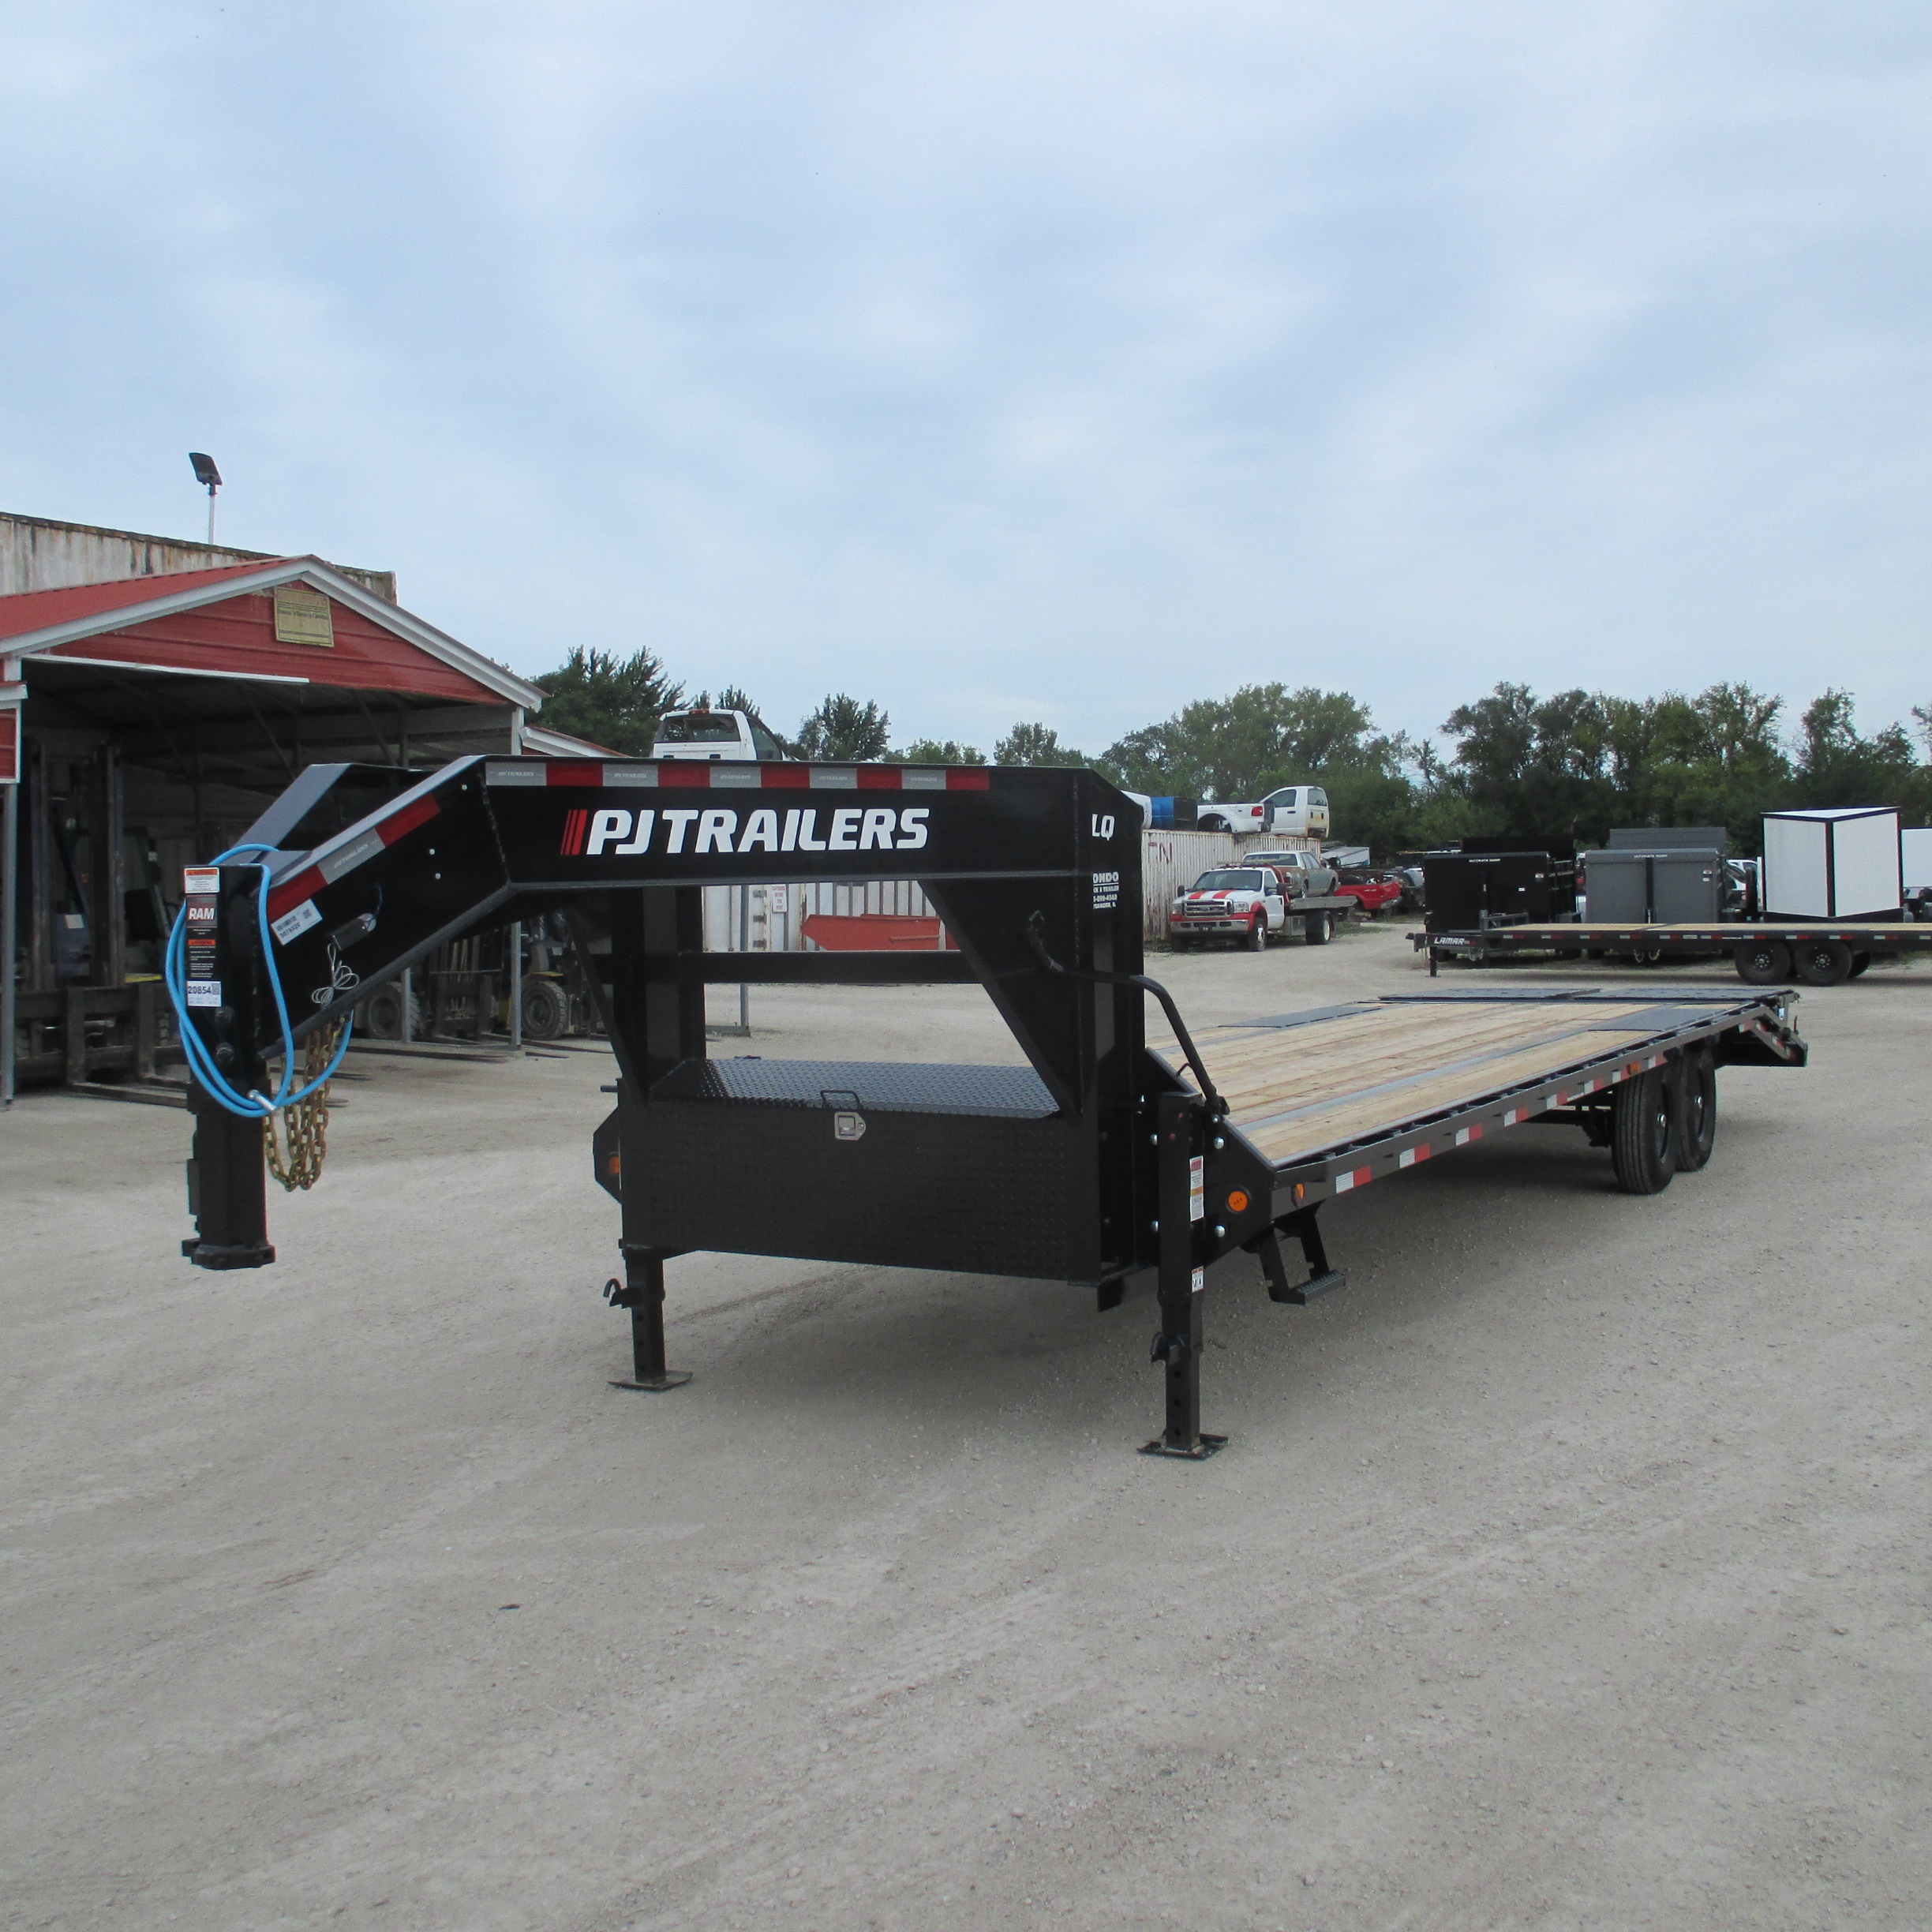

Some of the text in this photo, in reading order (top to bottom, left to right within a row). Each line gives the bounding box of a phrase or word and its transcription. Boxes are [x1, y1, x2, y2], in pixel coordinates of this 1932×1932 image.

[586, 808, 930, 856] PJ TRAILERS
[1091, 814, 1115, 841] LQ
[188, 907, 215, 921] RAM
[1433, 936, 1466, 945] LAMAR
[188, 985, 212, 994] 20854
